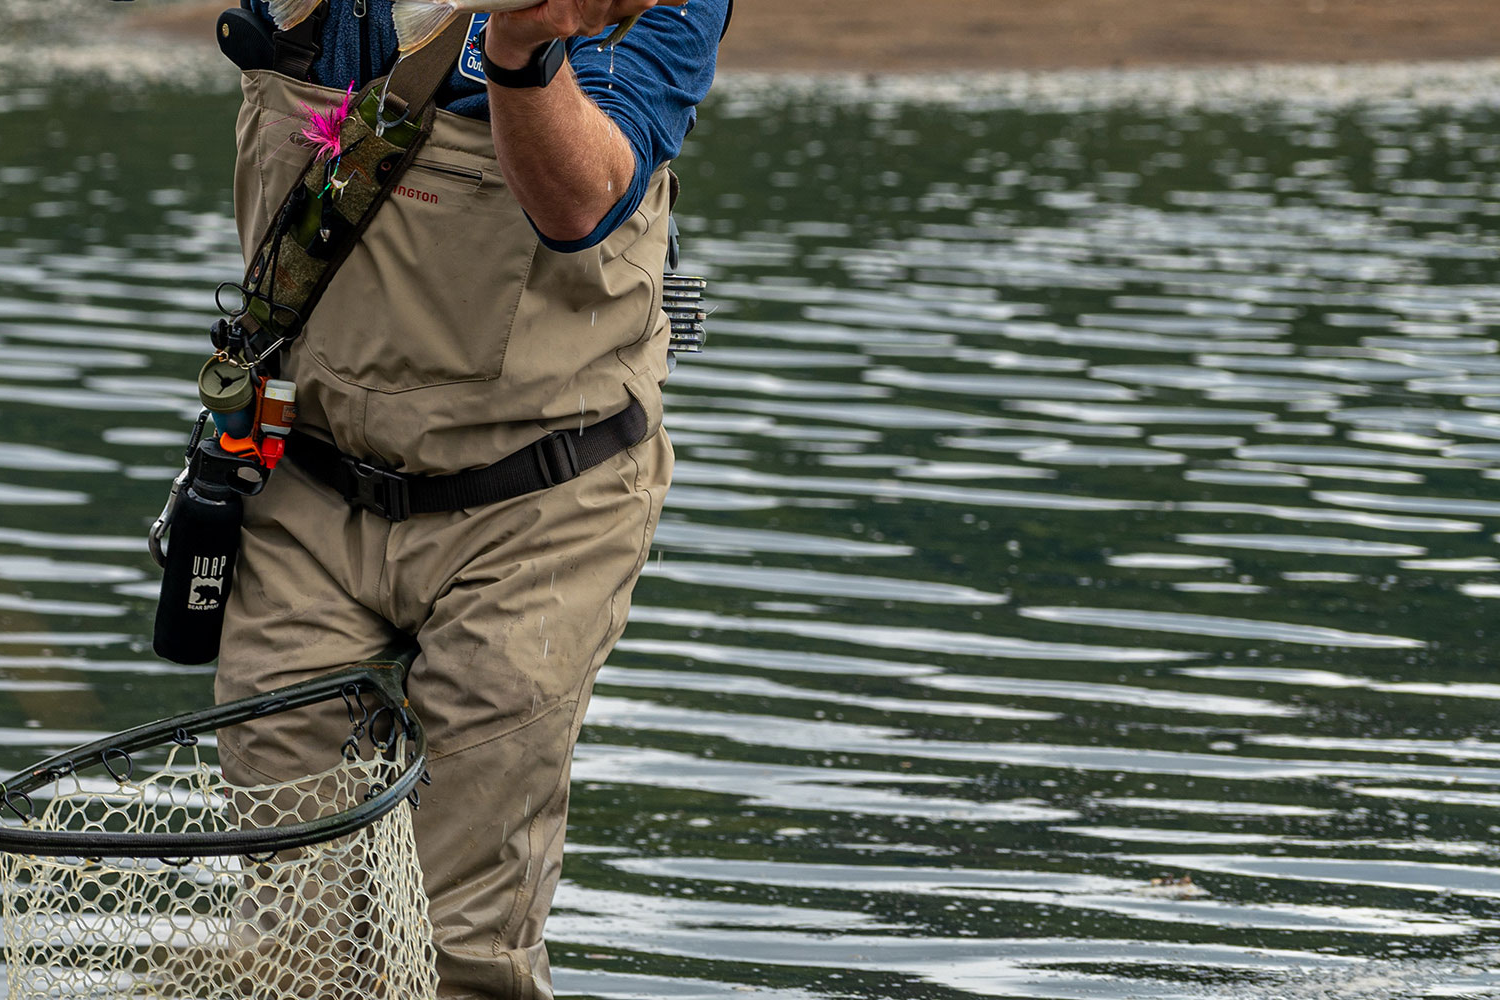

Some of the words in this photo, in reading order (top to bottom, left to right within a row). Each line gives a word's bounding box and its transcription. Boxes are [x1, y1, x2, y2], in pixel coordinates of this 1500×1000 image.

[192, 555, 227, 577] UDAP
[187, 603, 203, 611] BEAR
[203, 602, 220, 611] SPRAY
